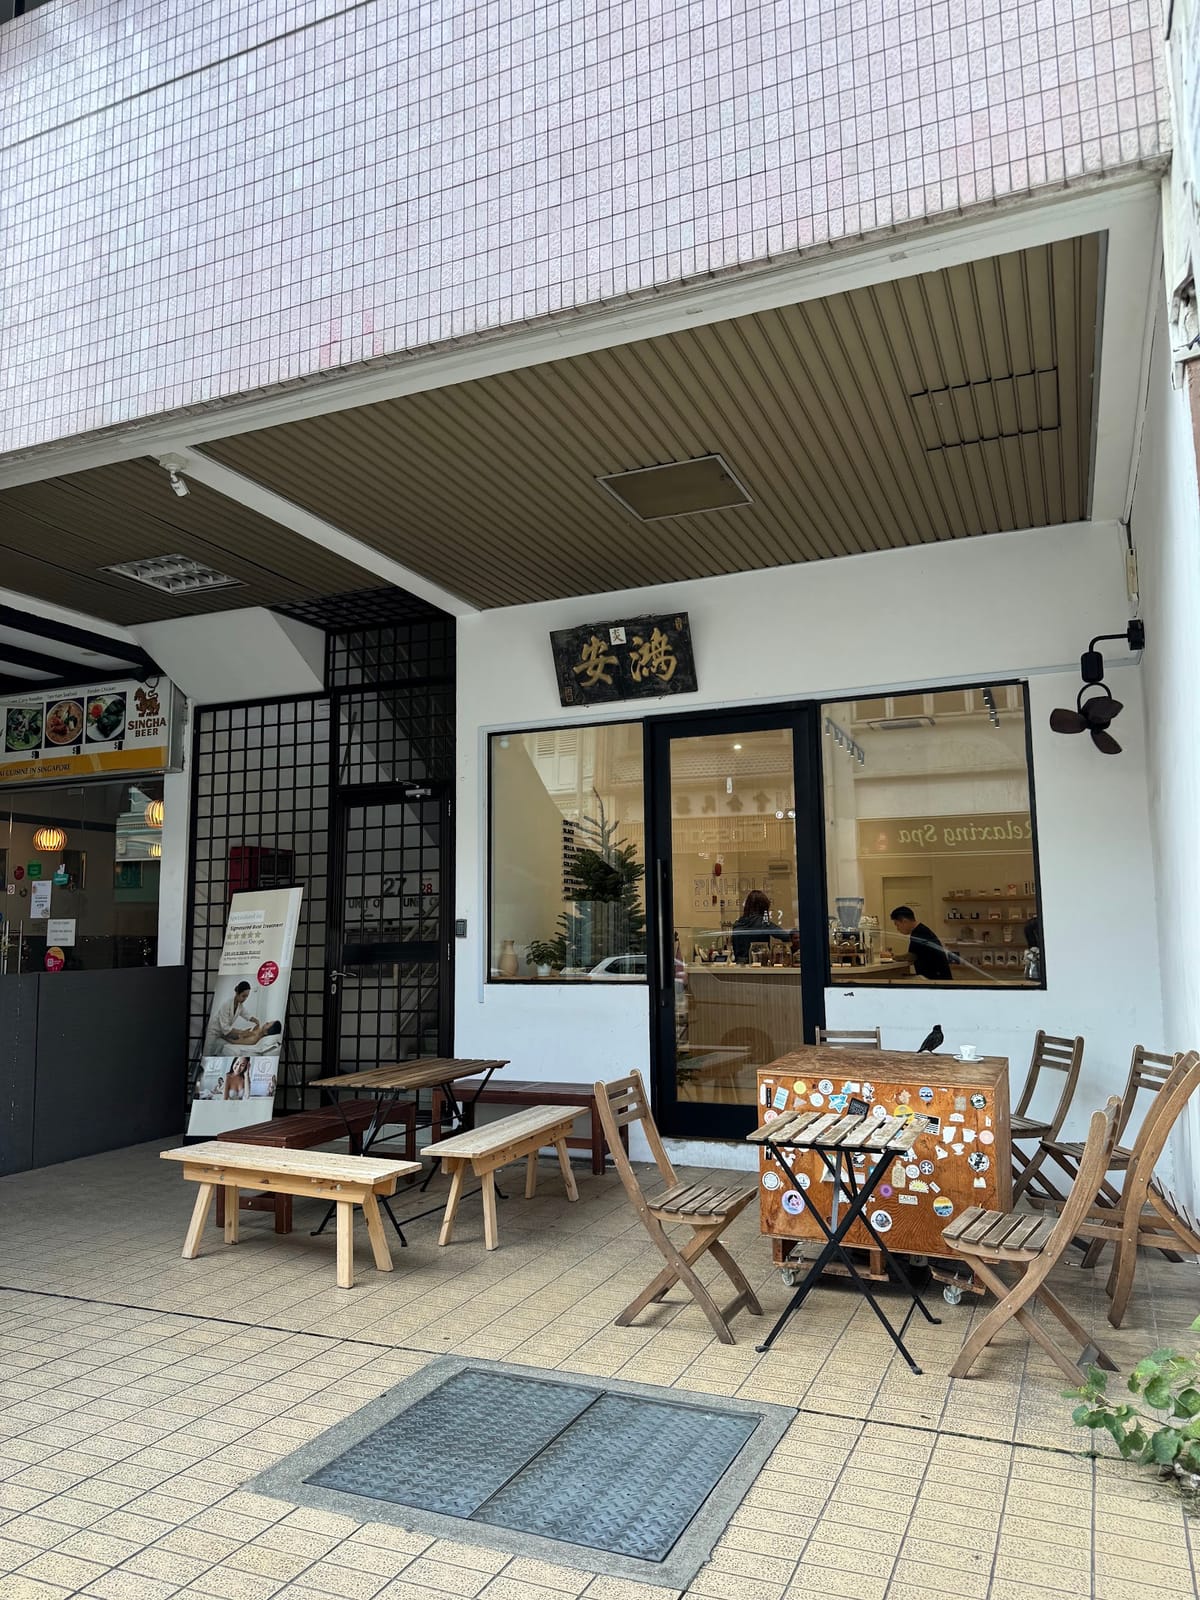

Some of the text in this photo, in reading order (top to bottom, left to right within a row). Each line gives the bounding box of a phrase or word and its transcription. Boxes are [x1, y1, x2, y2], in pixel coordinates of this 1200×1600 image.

[127, 717, 167, 731] SINGHA
[135, 728, 159, 738] BEER
[29, 766, 36, 775] IN
[37, 763, 70, 774] SINGAPORE
[694, 898, 740, 908] COEE
